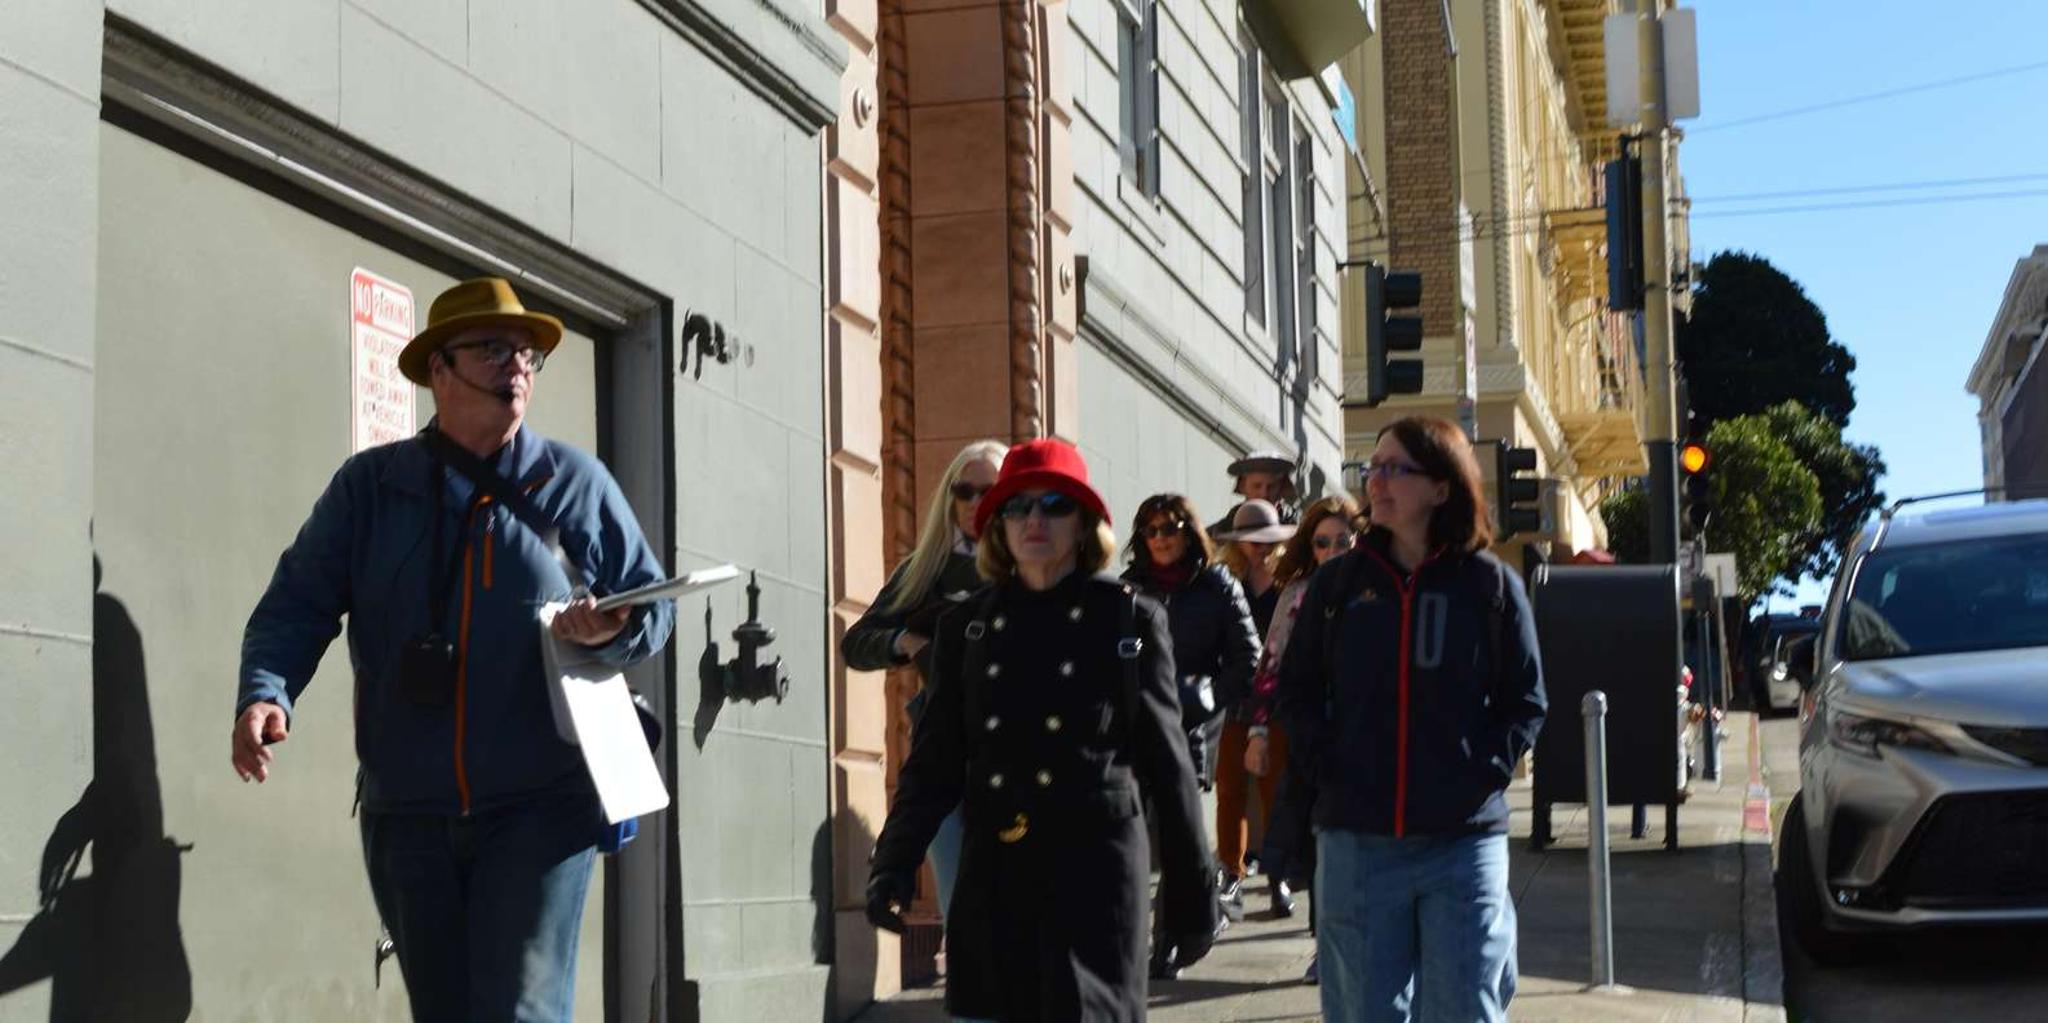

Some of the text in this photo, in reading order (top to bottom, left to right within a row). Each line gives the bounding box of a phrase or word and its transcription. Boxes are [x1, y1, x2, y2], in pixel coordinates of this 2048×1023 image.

[355, 282, 409, 328] NO PARKING
[368, 356, 386, 379] WILL
[360, 374, 409, 407] TOWED AWAY
[362, 400, 406, 430] AT VEHICLE
